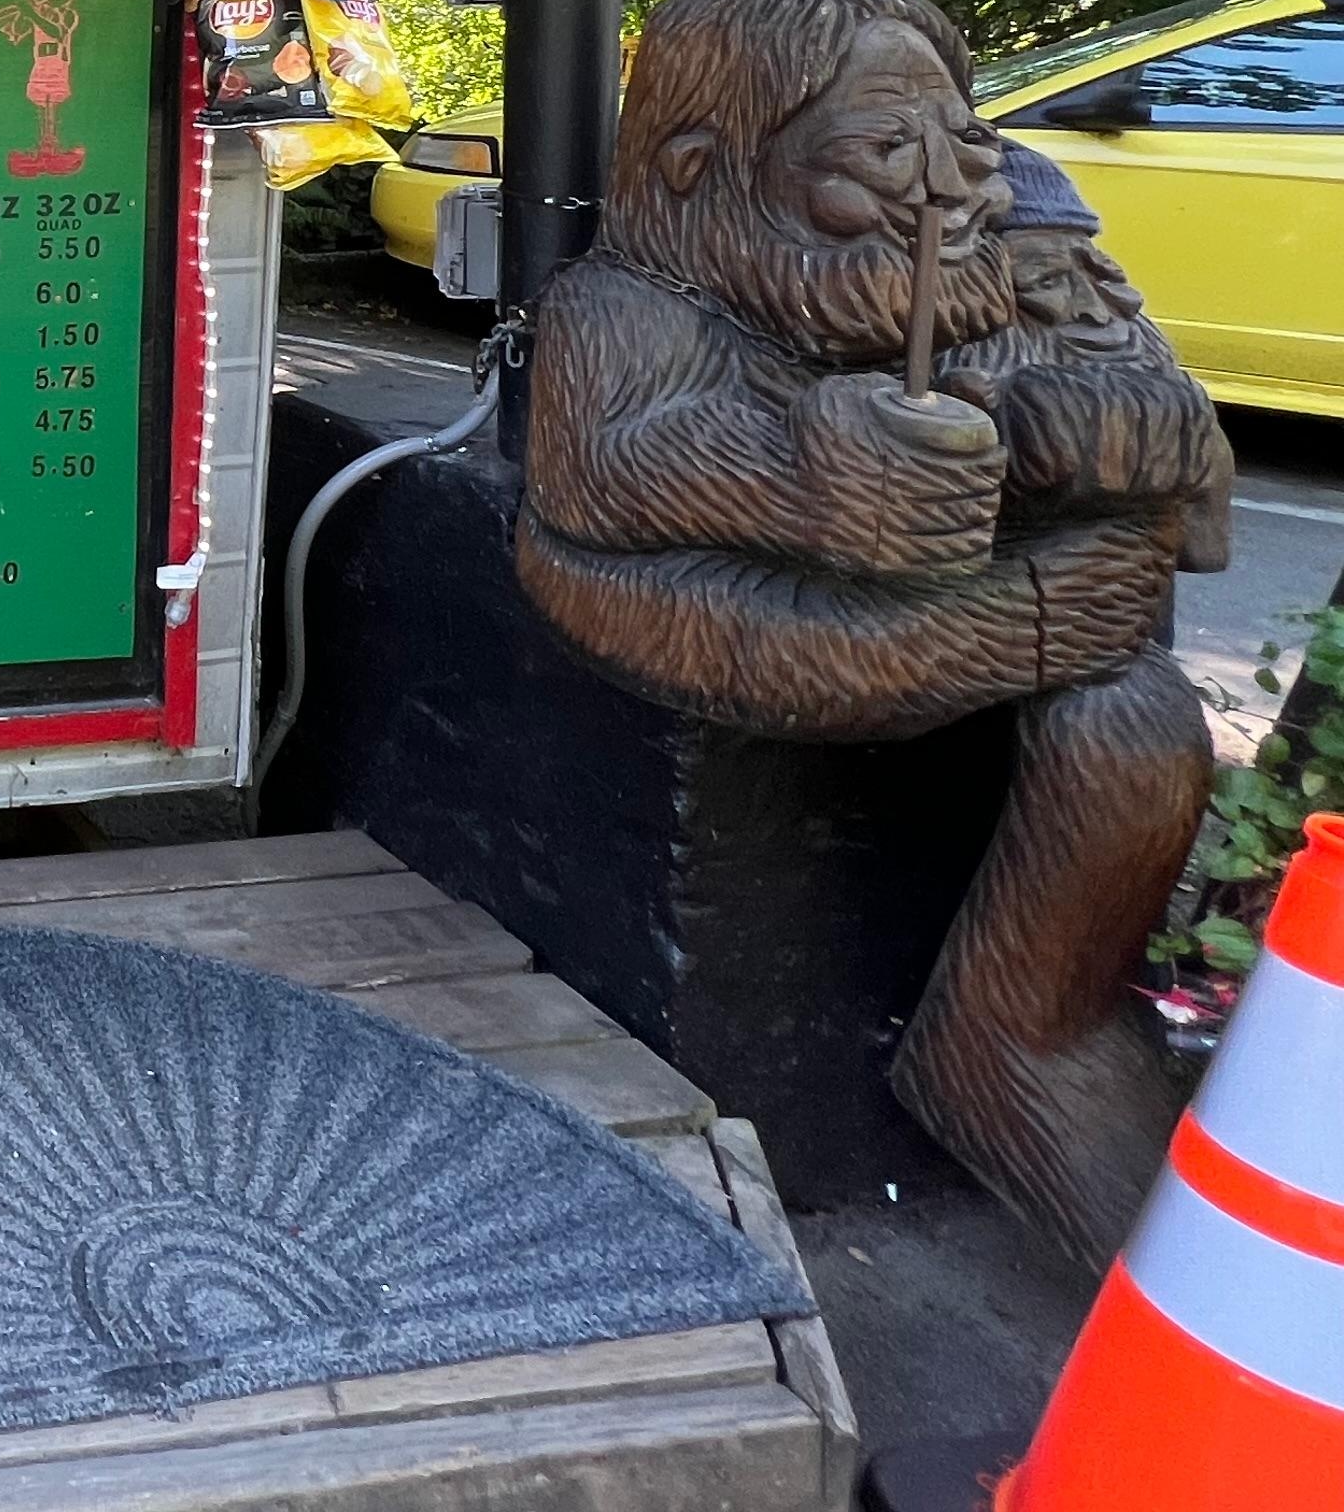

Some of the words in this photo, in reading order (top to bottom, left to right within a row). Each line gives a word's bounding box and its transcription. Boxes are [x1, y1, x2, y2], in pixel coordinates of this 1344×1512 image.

[36, 219, 82, 232] QUAD
[38, 237, 101, 261] 5.50
[38, 323, 99, 348] 1.50
[32, 455, 95, 477] 5.50
